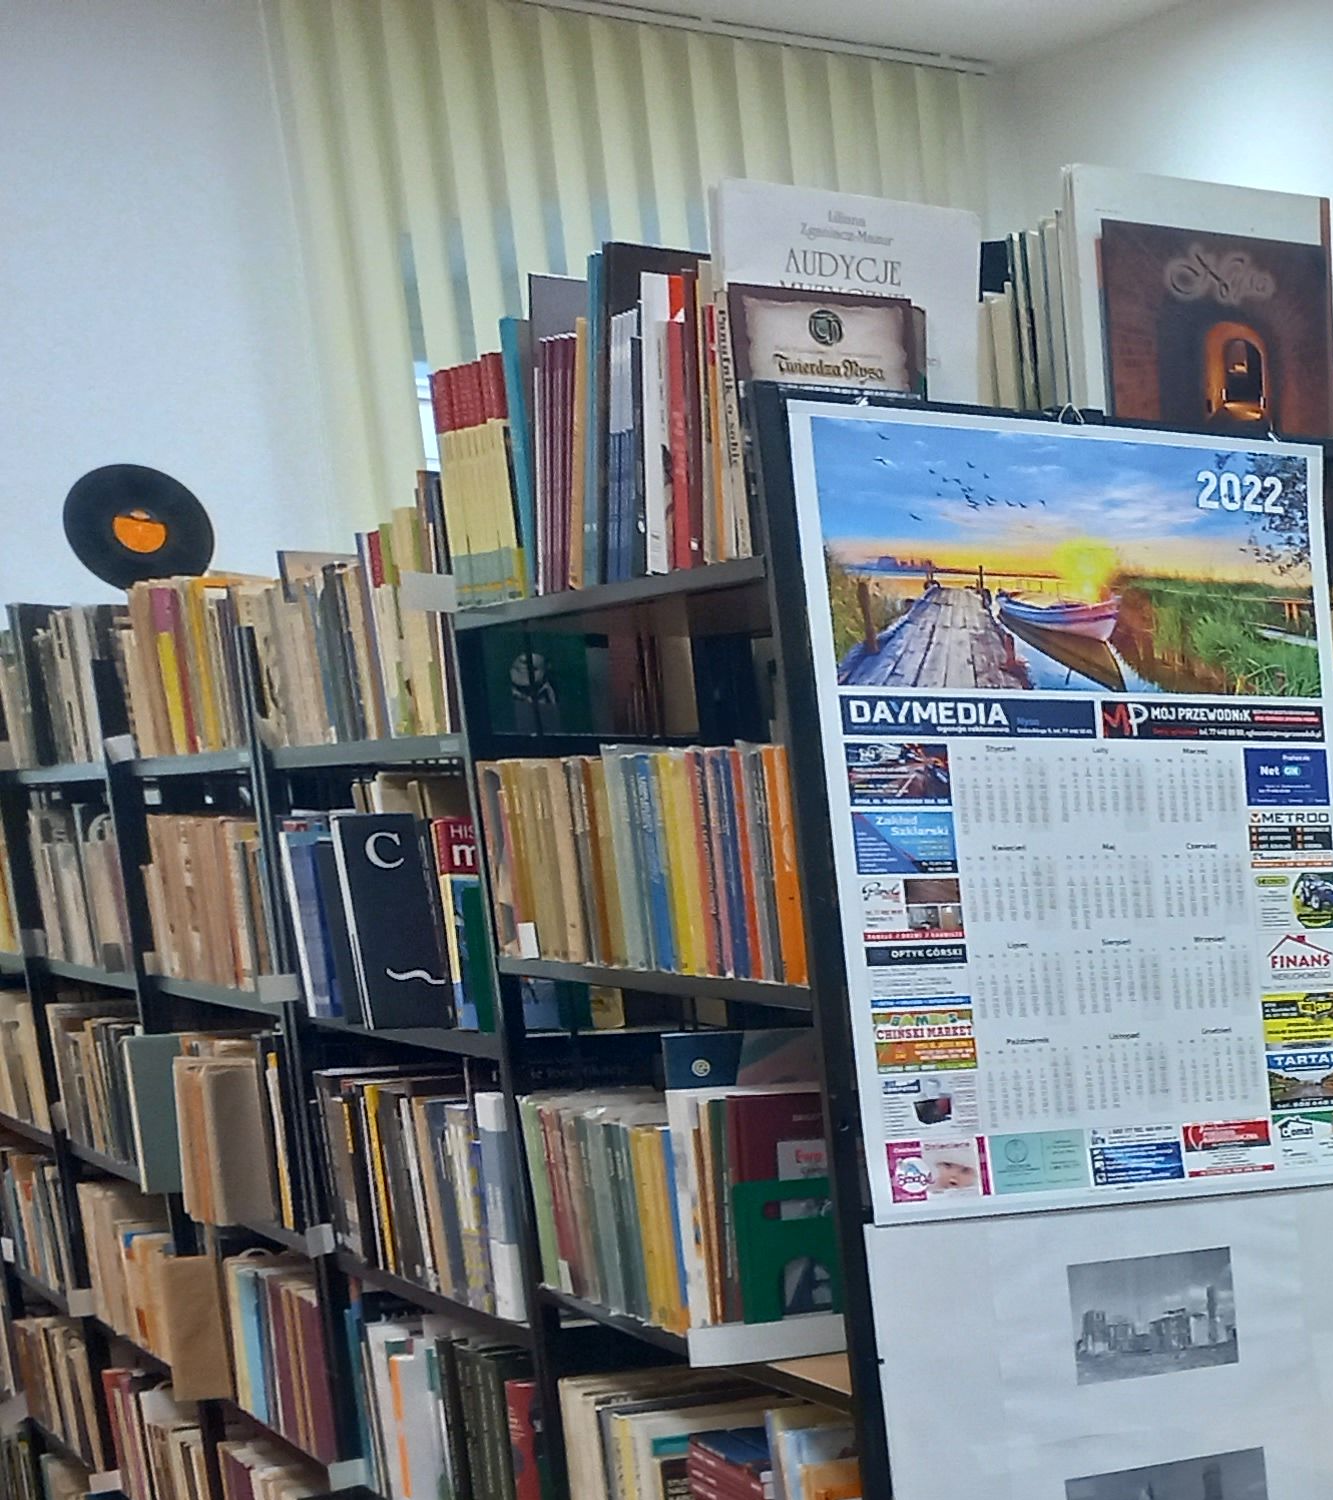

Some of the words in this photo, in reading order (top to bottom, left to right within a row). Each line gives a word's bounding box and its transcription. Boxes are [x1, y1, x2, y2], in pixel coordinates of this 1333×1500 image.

[785, 248, 902, 287] AUDYCJE
[1196, 470, 1285, 516] 2022
[850, 700, 1009, 726] DAYMEDIA
[365, 832, 404, 869] C
[1271, 954, 1330, 968] FINANS
[927, 1026, 972, 1038] MARKET
